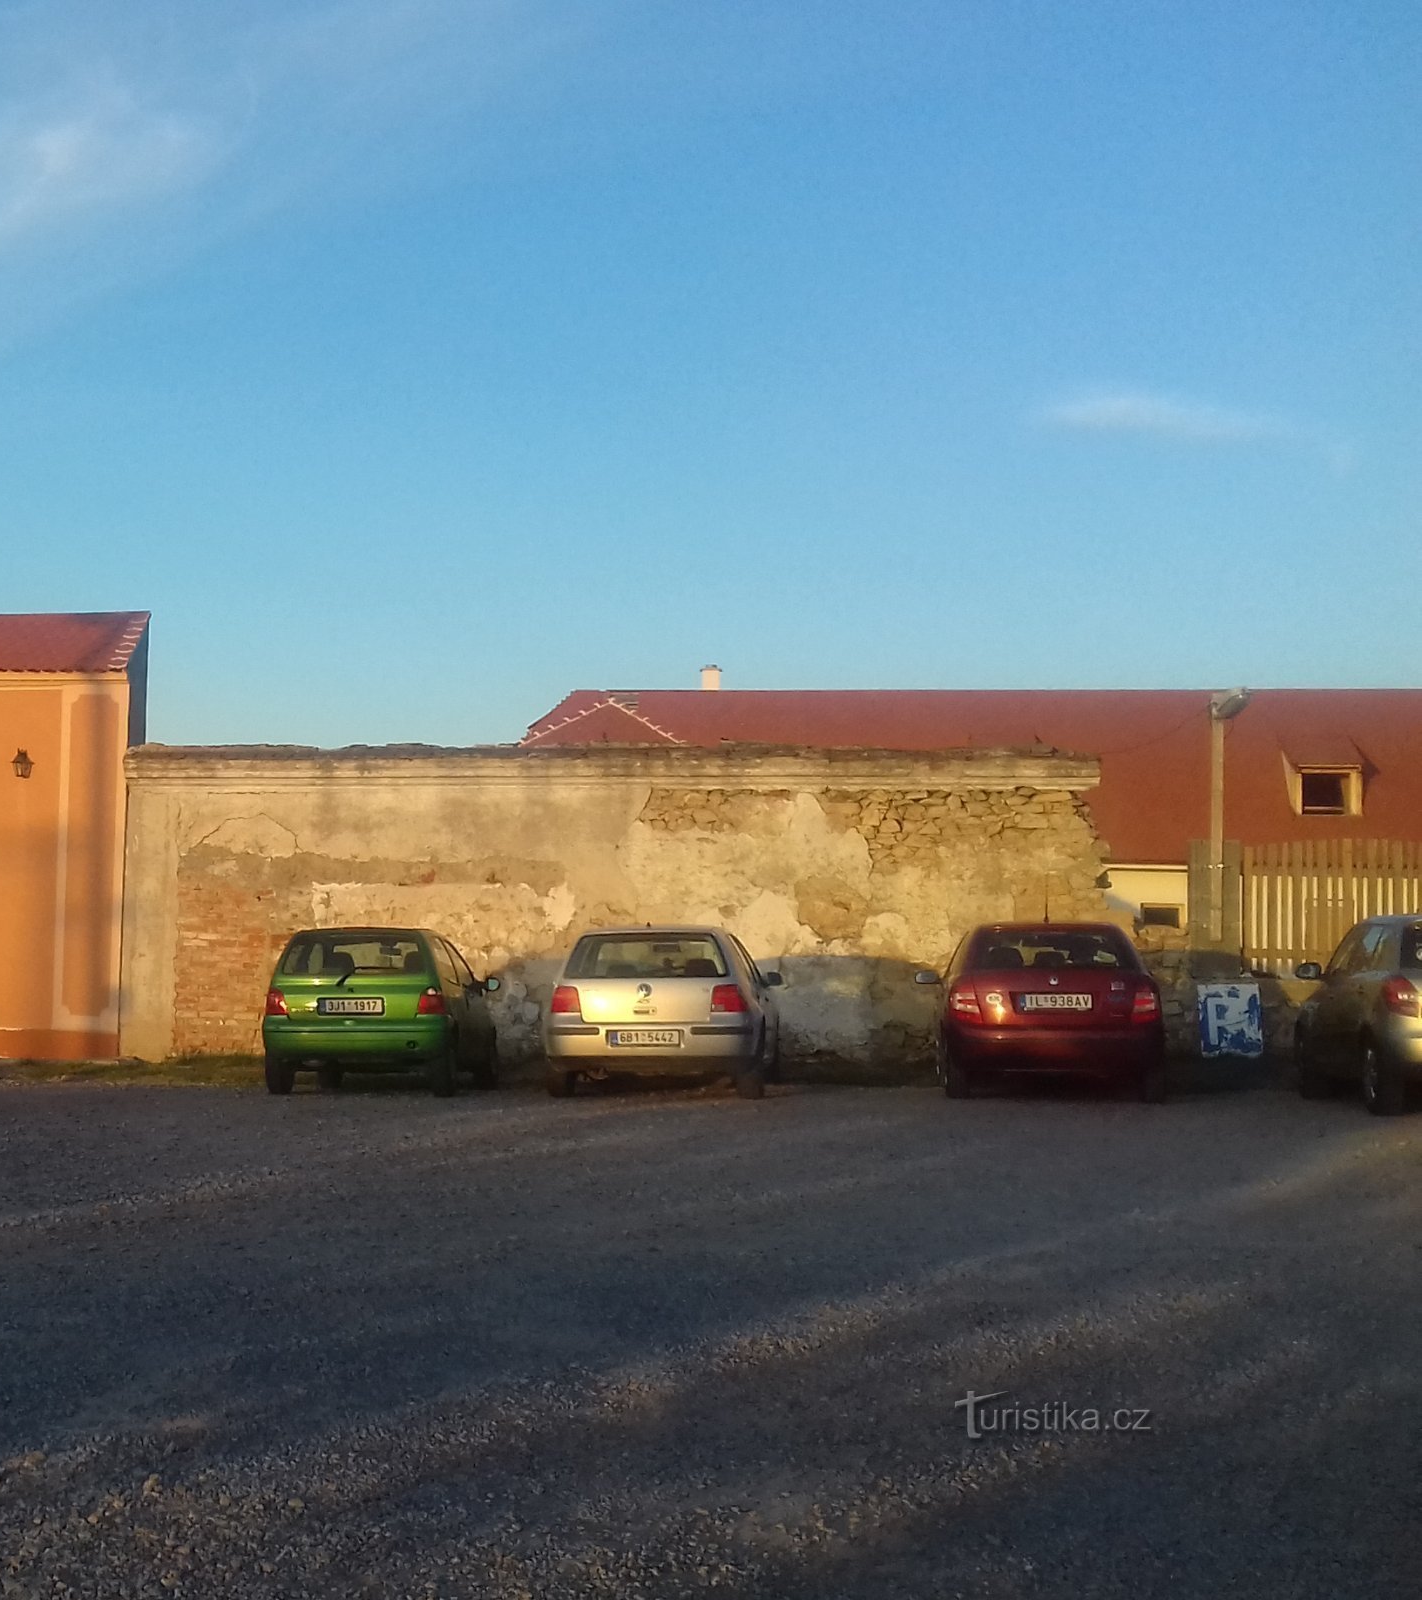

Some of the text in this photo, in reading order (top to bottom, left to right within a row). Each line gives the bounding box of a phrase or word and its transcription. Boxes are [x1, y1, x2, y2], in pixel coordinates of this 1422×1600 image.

[327, 1001, 377, 1011] 3J1 1917
[1049, 996, 1090, 1007] 938AV
[619, 1032, 674, 1043] 6B1 5442
